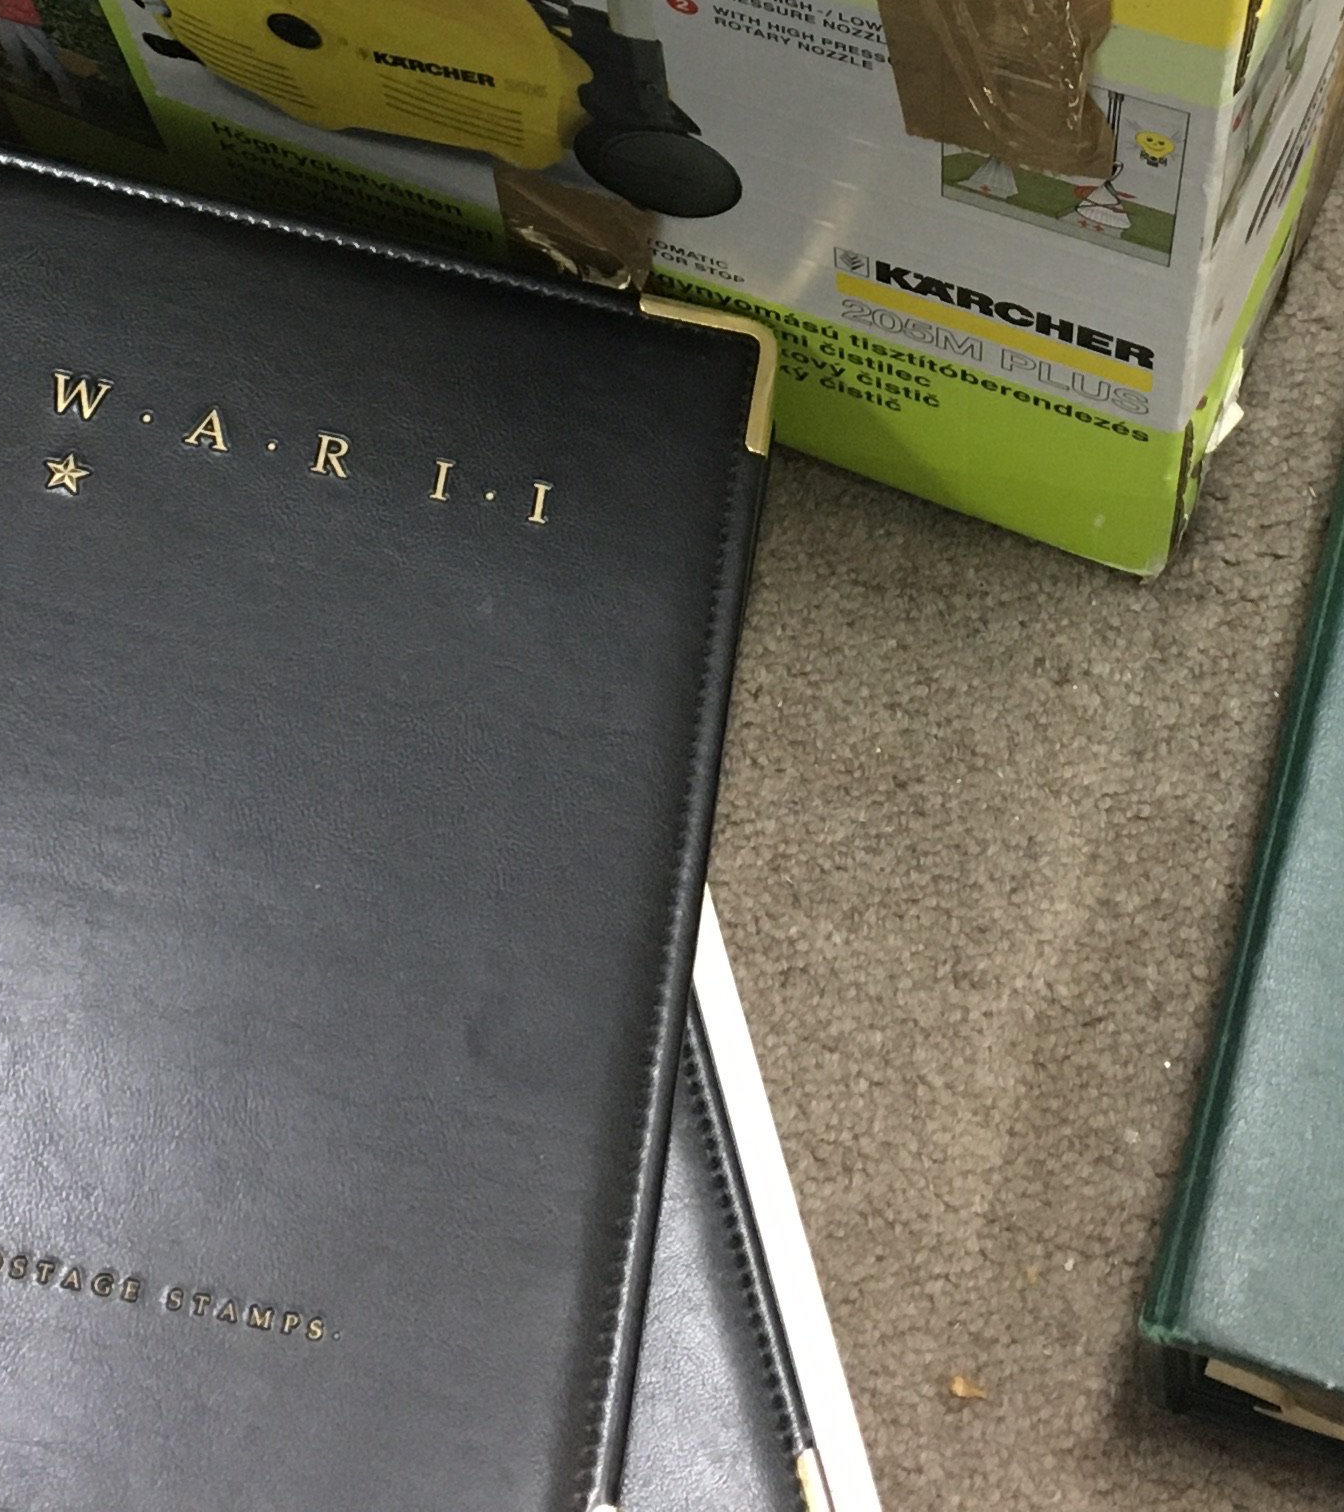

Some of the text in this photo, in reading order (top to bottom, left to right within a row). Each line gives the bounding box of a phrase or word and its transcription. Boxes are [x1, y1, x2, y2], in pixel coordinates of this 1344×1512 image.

[713, 5, 761, 27] WITH
[768, 22, 815, 42] HIGH
[822, 18, 887, 44] NOZZL
[838, 12, 884, 32] LOW
[714, 16, 874, 70] ROTARY NOZZLE
[373, 50, 496, 88] KÄRCHER
[694, 260, 746, 284] STOP
[875, 260, 1155, 370] KÄRCHER
[654, 271, 1149, 443] gynyomású tisztítóberendezés
[819, 341, 932, 388] čistilec
[841, 298, 1150, 416] 205M PLUS
[819, 376, 902, 412] čistič
[856, 368, 941, 408] čistič
